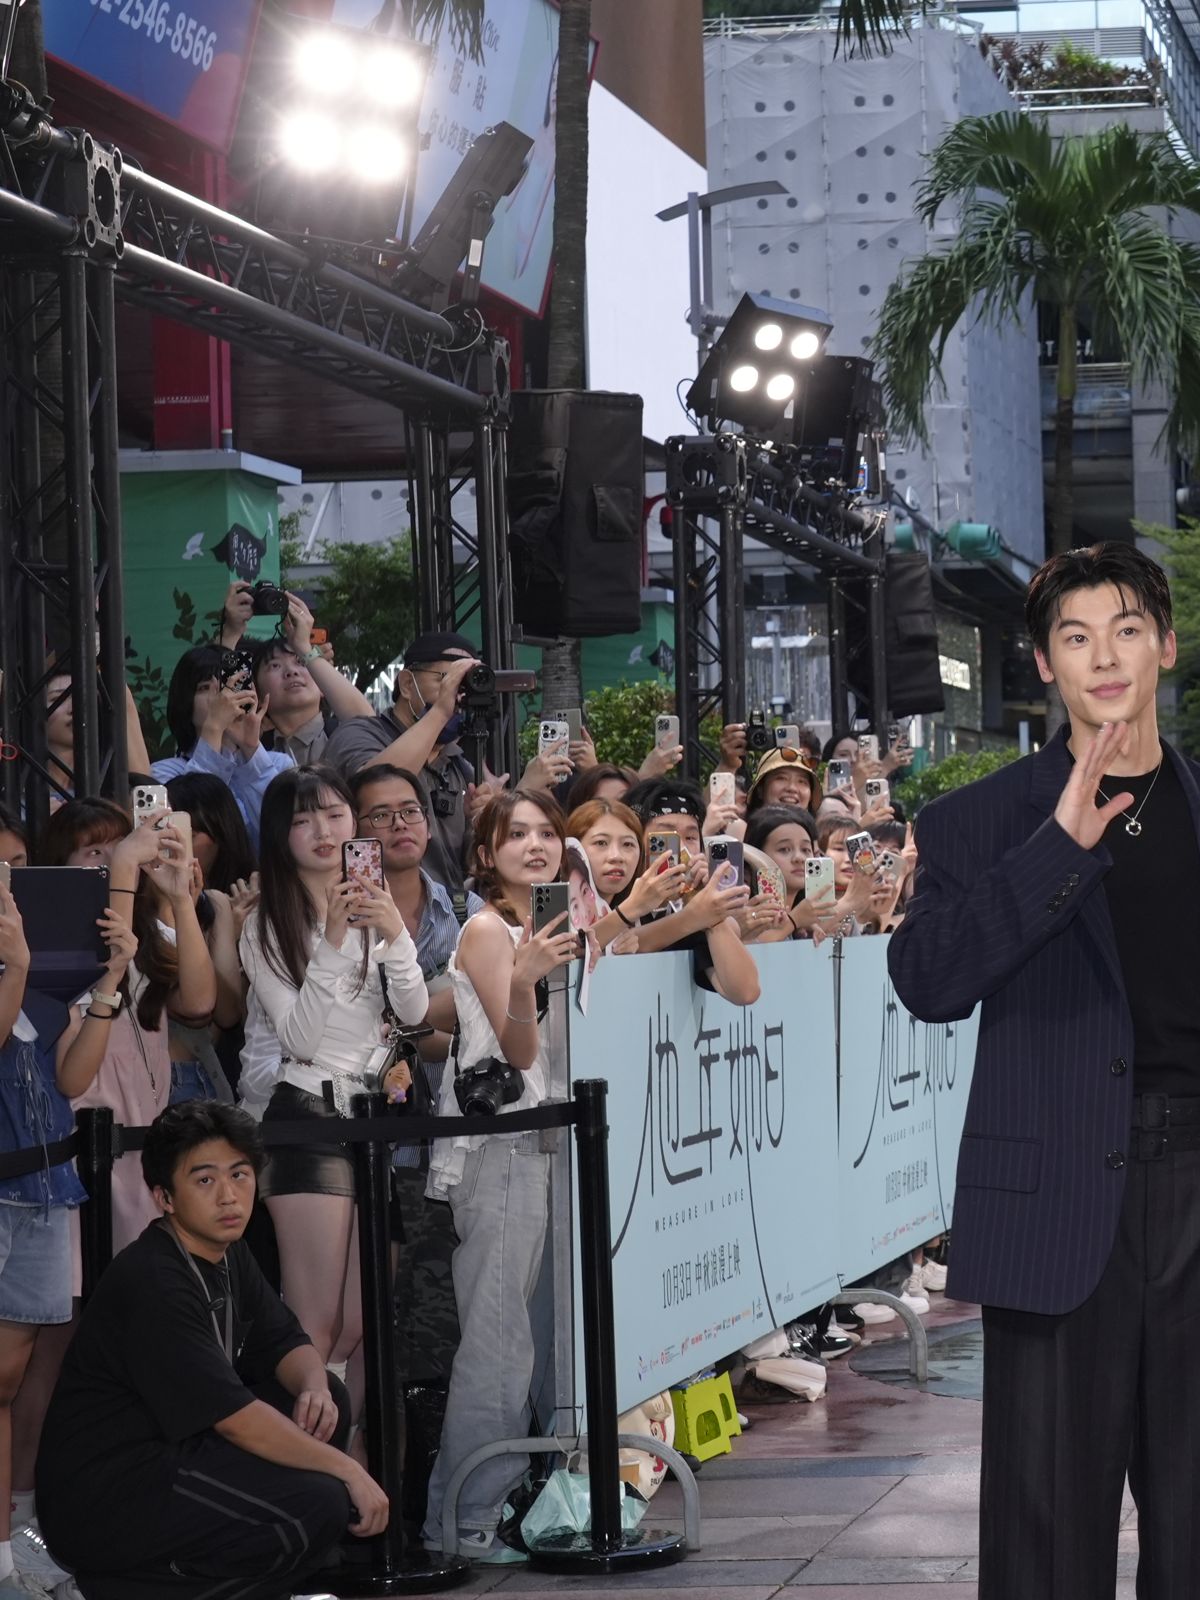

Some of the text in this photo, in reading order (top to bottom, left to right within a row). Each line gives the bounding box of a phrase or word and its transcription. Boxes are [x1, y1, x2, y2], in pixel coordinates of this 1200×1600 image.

[88, 0, 217, 72] -2546-8566
[612, 990, 785, 1259] 他年她日
[654, 1187, 744, 1233] MEASURE IN LOVE
[662, 1237, 741, 1310] 10月3日 中秋浪漫上映
